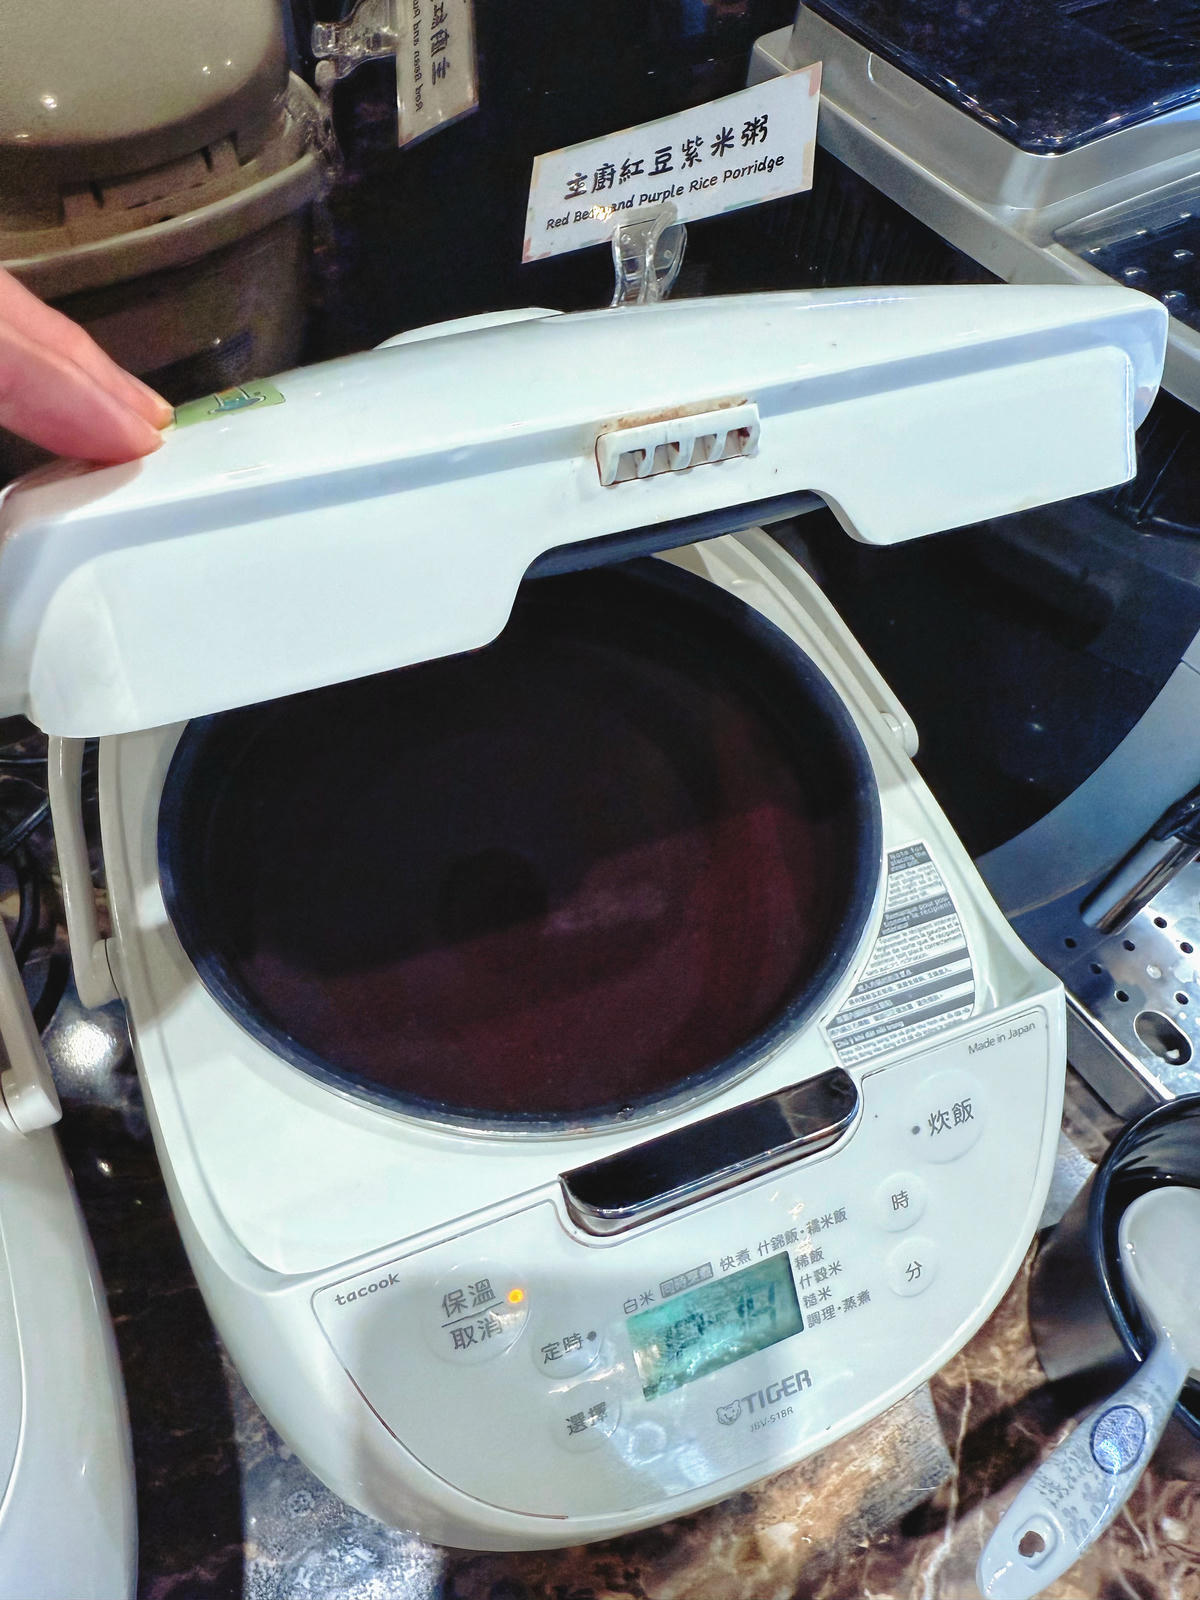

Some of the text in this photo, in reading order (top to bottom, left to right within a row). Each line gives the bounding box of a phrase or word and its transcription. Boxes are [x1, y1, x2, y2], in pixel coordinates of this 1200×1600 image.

[563, 114, 769, 200] 主廚紅豆紫米粥
[546, 212, 570, 230] Red
[639, 184, 685, 206] Purple
[688, 175, 718, 193] Rice
[722, 155, 785, 183] Porridge
[968, 1022, 1036, 1055] Made in Japan
[927, 1098, 975, 1137] 炊飯
[891, 1190, 909, 1211] 時
[334, 1272, 401, 1306] tacook
[623, 1289, 655, 1314] 白米
[719, 1248, 752, 1271] 快煮
[905, 1261, 922, 1282] 分
[441, 1278, 497, 1318] 保溫
[450, 1316, 504, 1350] 取消
[541, 1332, 583, 1364] 定時
[741, 1369, 812, 1414] TIGER
